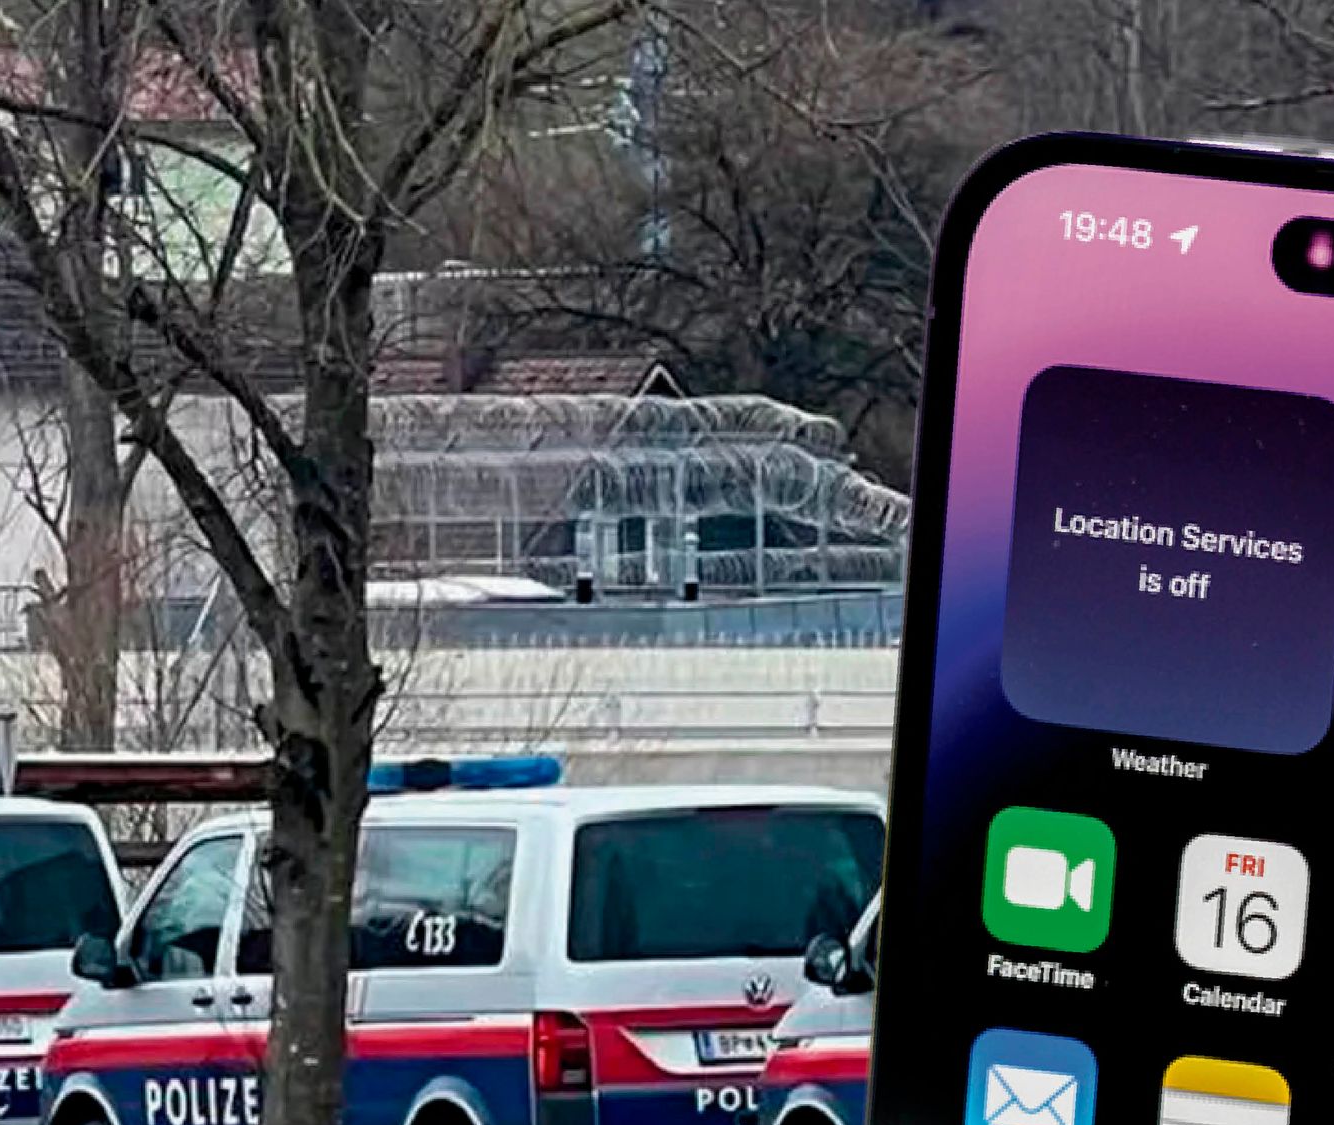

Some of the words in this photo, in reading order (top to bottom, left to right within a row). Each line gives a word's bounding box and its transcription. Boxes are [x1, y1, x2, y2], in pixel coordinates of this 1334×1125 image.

[1060, 210, 1151, 249] 19:48
[1054, 507, 1174, 546] Location
[1180, 523, 1304, 564] Services
[1139, 563, 1162, 593] is
[1169, 571, 1211, 599] off
[1112, 748, 1209, 780] Weather
[1225, 853, 1265, 878] FRI
[424, 915, 456, 955] 133
[1203, 886, 1279, 955] 16
[987, 954, 1094, 989] FaceTime
[1182, 982, 1286, 1017] Calendar
